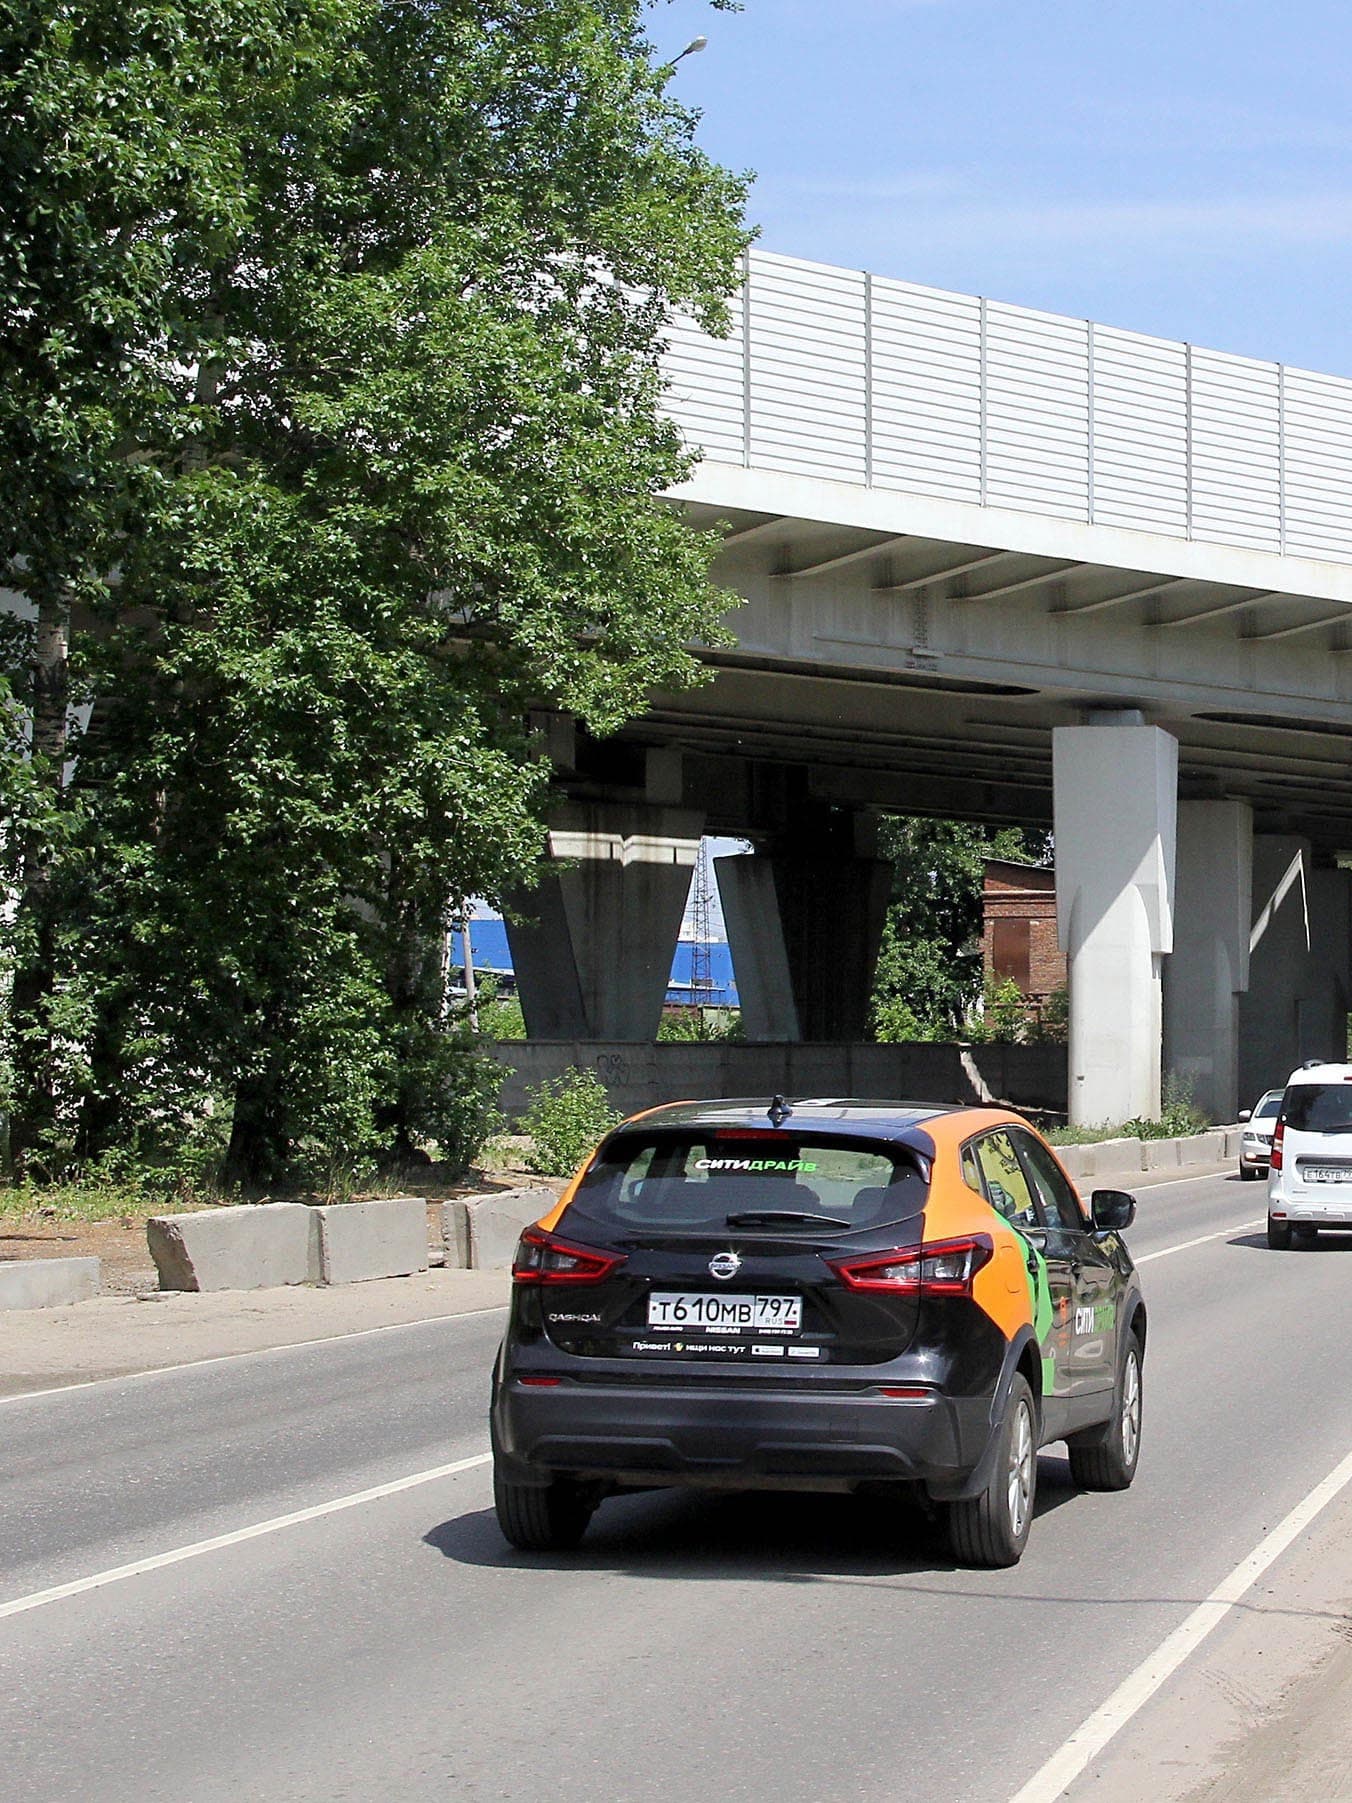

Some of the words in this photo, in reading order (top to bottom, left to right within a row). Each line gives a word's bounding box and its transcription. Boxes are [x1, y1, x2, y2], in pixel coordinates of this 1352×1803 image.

[694, 1159, 817, 1172] СИТИДРАЙВ
[658, 1297, 751, 1323] Т610МВ
[757, 1298, 795, 1317] 797
[765, 1317, 783, 1325] RUS
[705, 1326, 741, 1335] NISSAN
